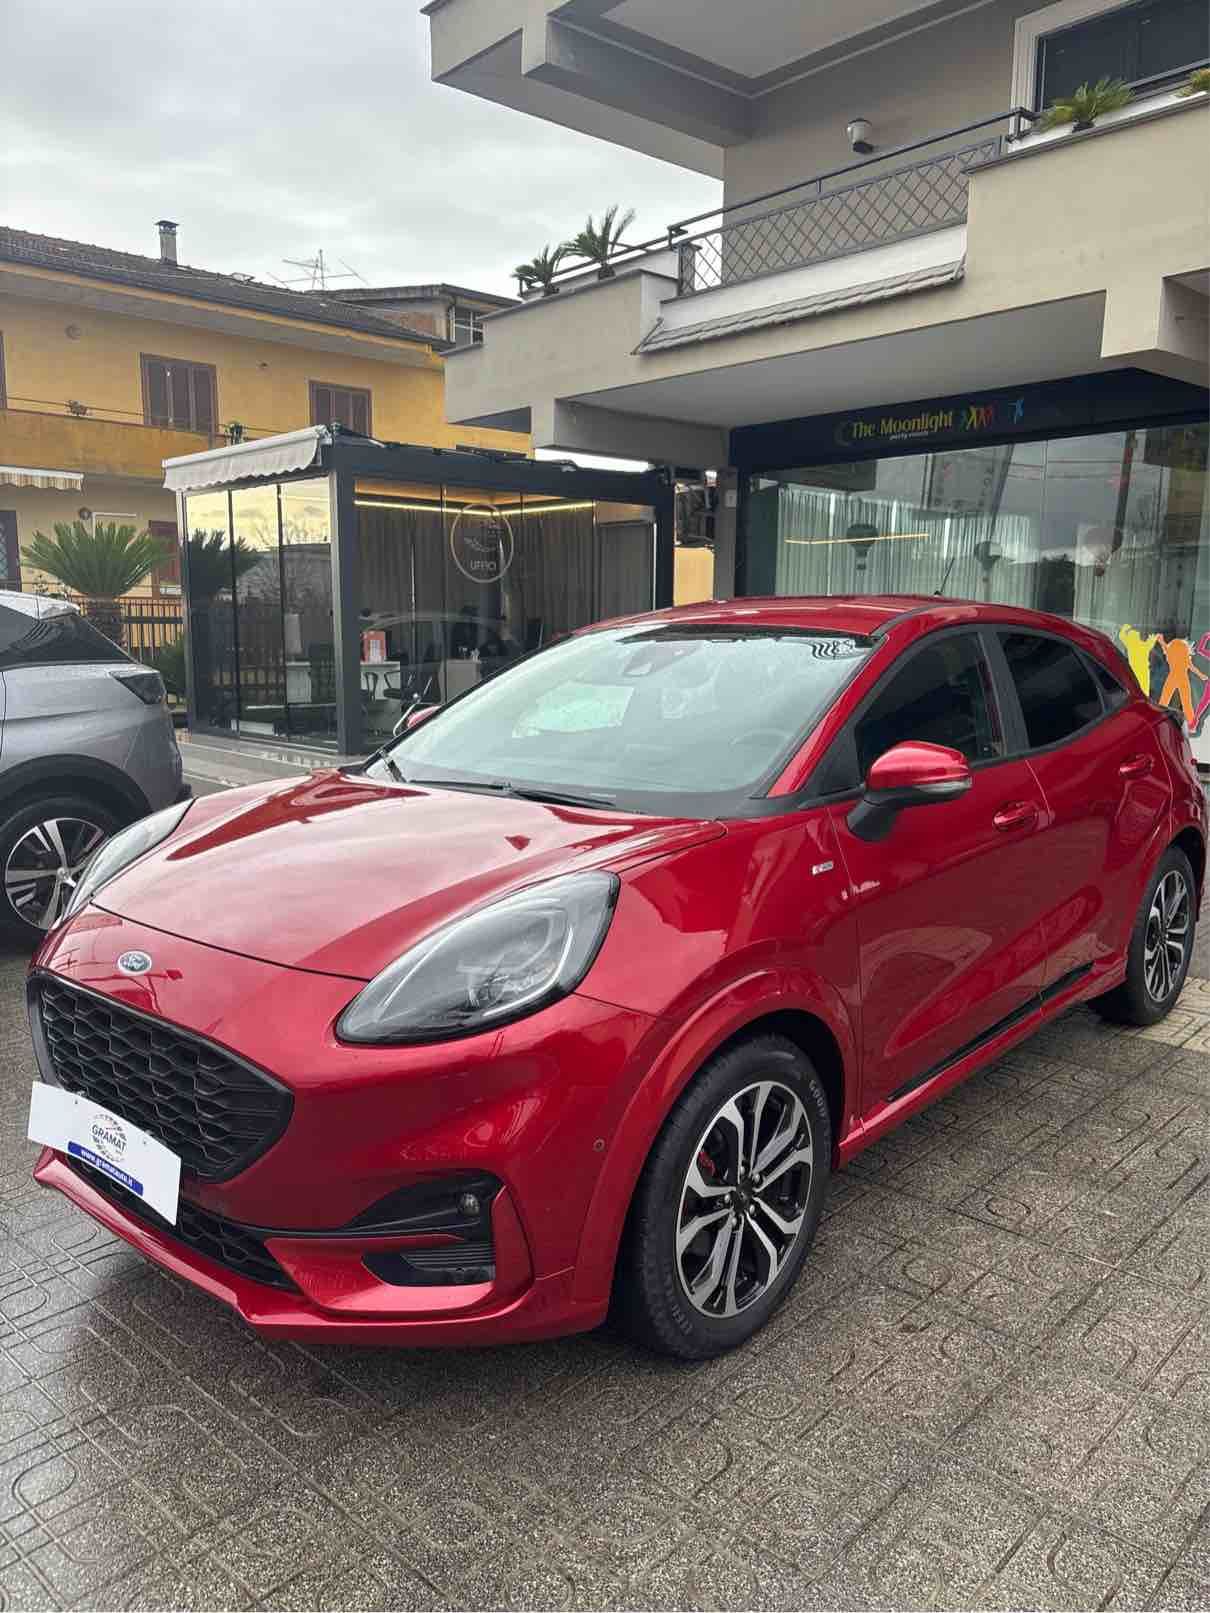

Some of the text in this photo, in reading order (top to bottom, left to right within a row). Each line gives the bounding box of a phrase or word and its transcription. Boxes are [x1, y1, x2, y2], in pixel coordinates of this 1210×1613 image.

[852, 411, 953, 440] The Moonlight
[91, 1124, 127, 1152] GRAMAT
